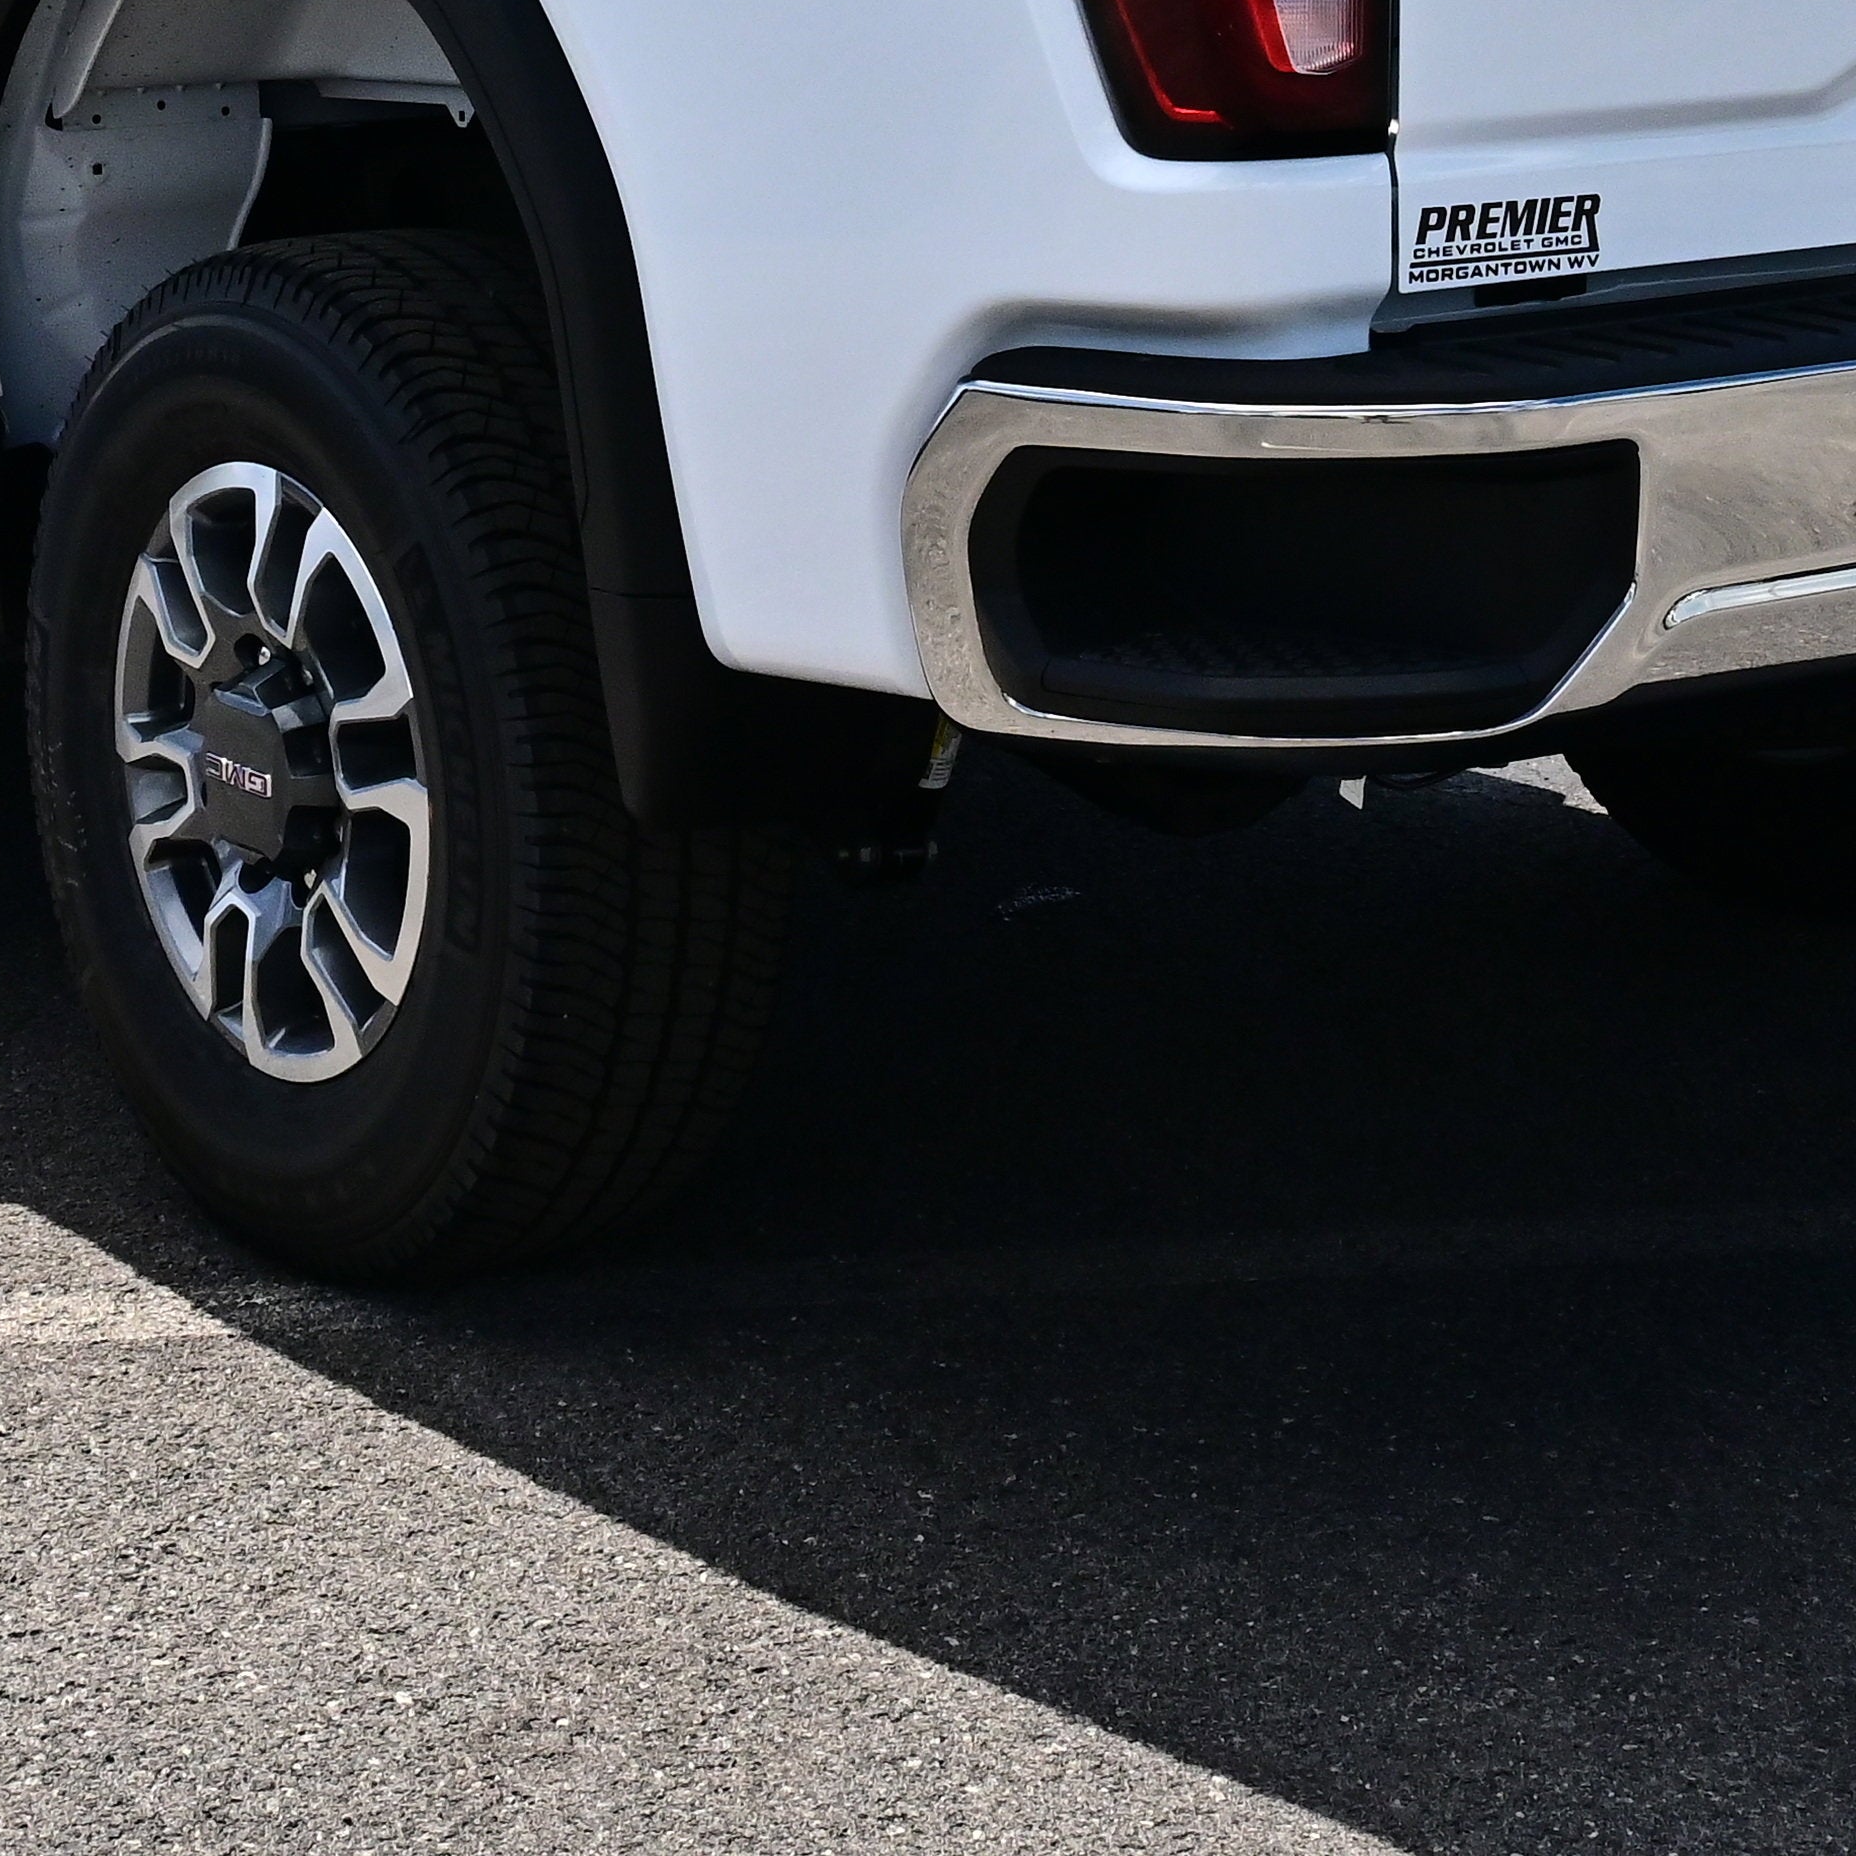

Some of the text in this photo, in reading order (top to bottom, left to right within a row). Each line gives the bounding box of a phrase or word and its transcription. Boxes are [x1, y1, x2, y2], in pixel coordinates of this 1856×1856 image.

[1415, 193, 1601, 252] PREMIER
[1413, 234, 1583, 260] CHEVROLET GMC
[1408, 254, 1600, 285] MORGANTOWN WV
[206, 751, 273, 799] GMC
